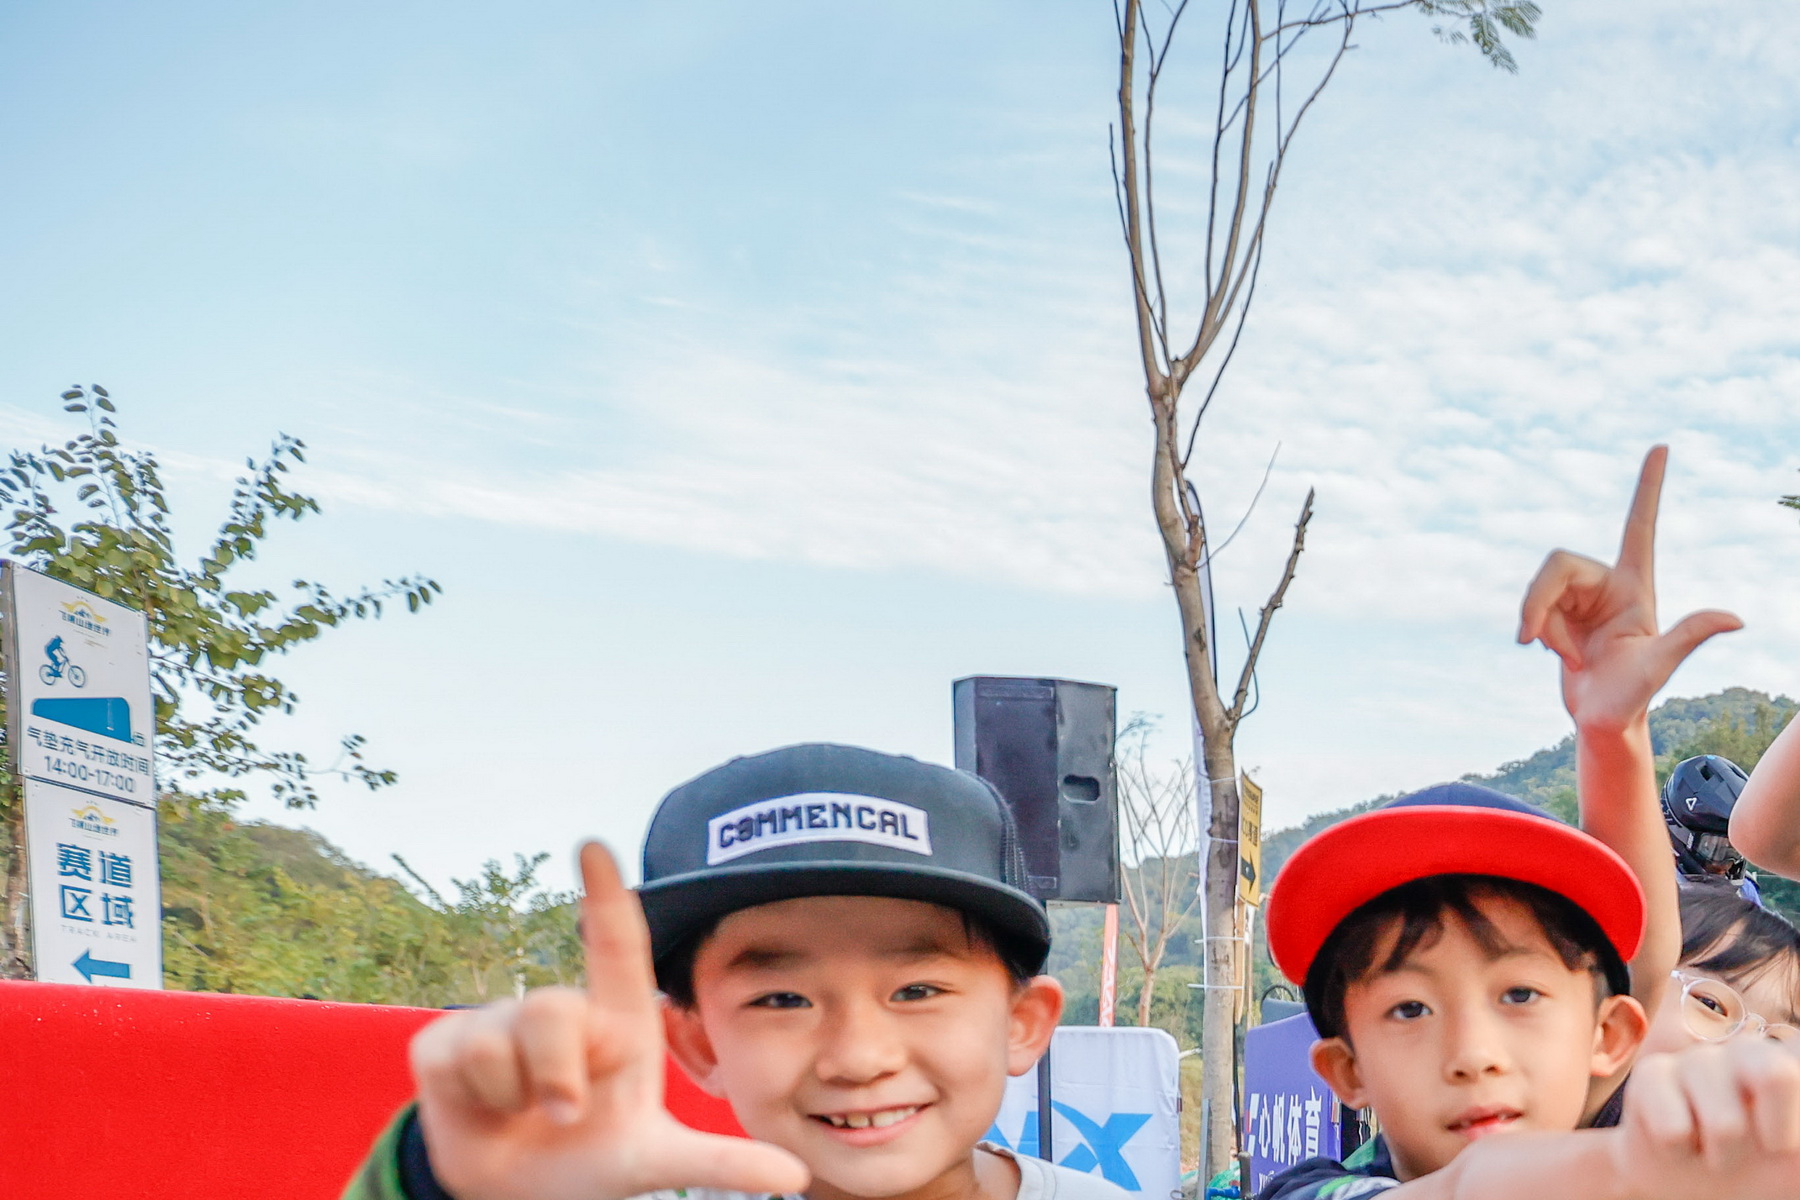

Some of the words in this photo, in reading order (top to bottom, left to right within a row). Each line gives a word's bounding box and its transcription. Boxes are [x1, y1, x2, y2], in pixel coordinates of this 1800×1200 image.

[27, 725, 150, 777] 气垫充气开放时间
[44, 755, 136, 793] 14:00-17:00
[719, 802, 919, 848] COMMENCAL
[56, 842, 134, 888] 赛道
[59, 884, 135, 929] 区域
